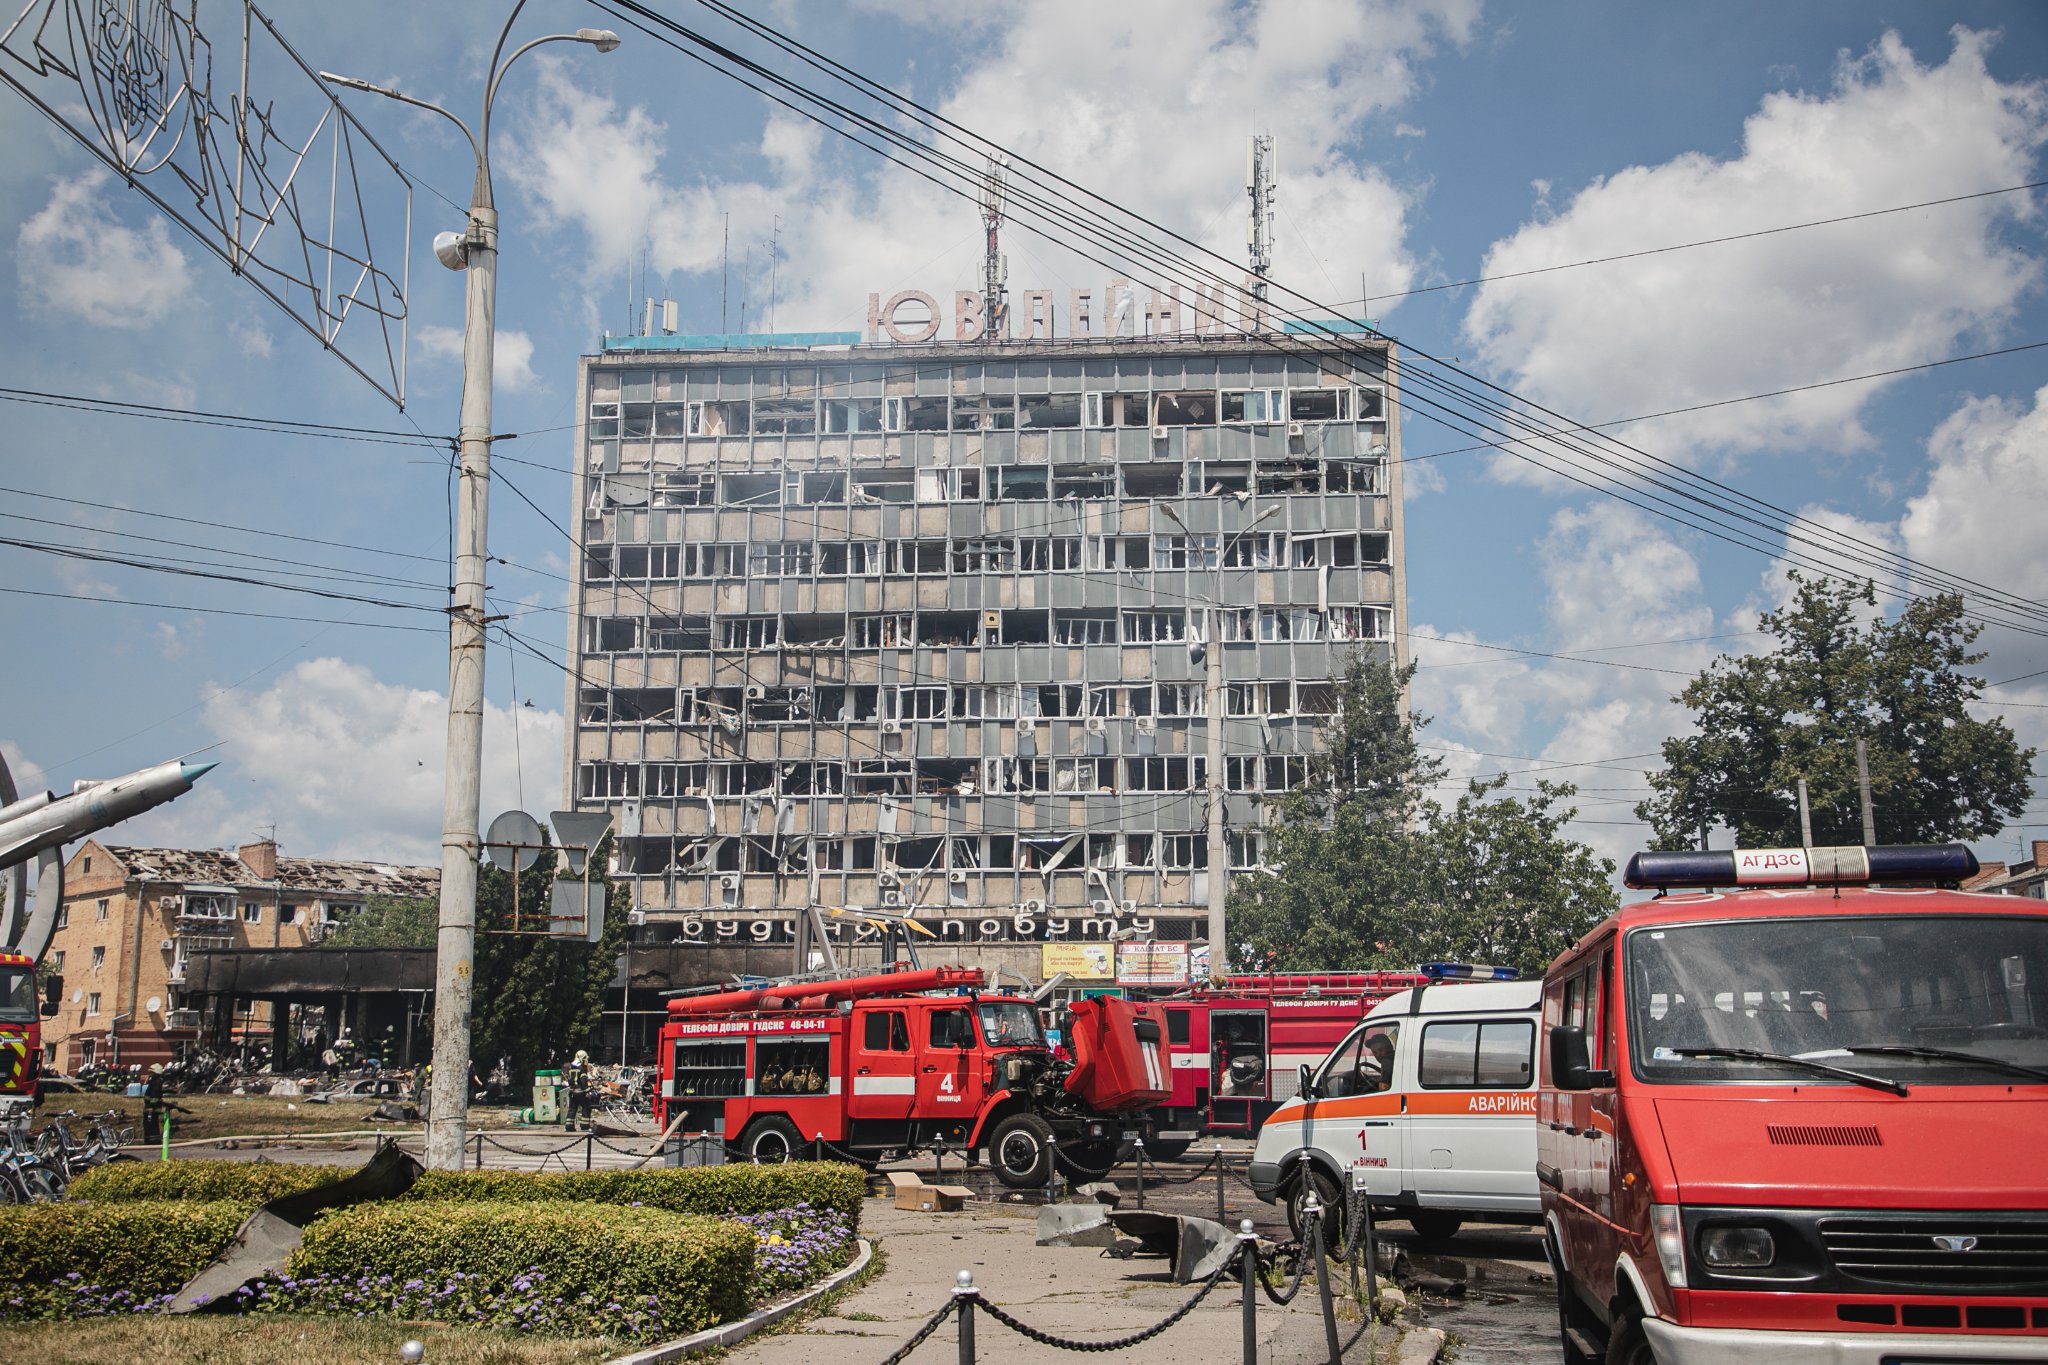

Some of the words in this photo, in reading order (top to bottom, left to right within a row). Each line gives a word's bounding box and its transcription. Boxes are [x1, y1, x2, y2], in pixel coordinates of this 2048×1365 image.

[1743, 854, 1801, 869] АГДЗС
[682, 1024, 718, 1034] ТЕЛЕФОН
[720, 1022, 749, 1034] ДОВІРИ
[941, 1072, 954, 1094] 4
[1358, 1129, 1367, 1151] 1
[1360, 1156, 1388, 1168] ВІННИЦЯ
